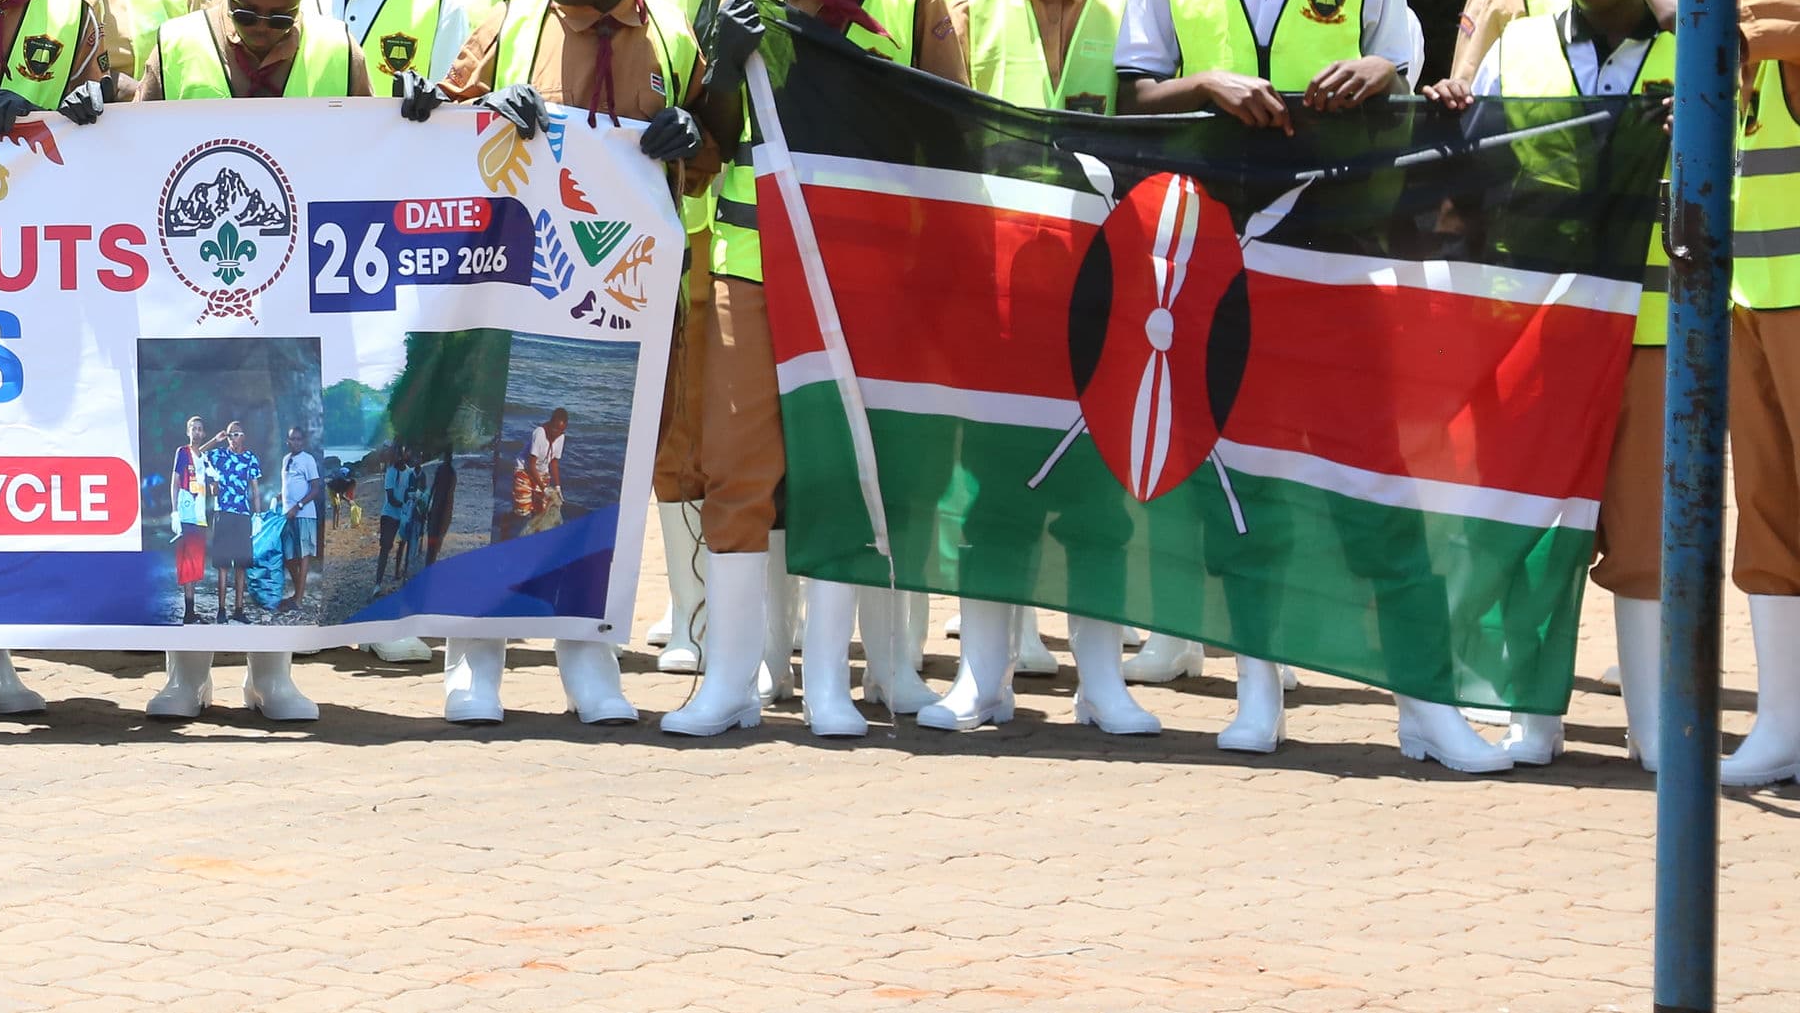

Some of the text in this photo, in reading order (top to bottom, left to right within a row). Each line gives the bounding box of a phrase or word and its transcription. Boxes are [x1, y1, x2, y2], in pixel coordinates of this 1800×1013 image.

[405, 199, 483, 230] DATE:
[314, 223, 390, 295] 26
[398, 245, 508, 276] SEP 2026
